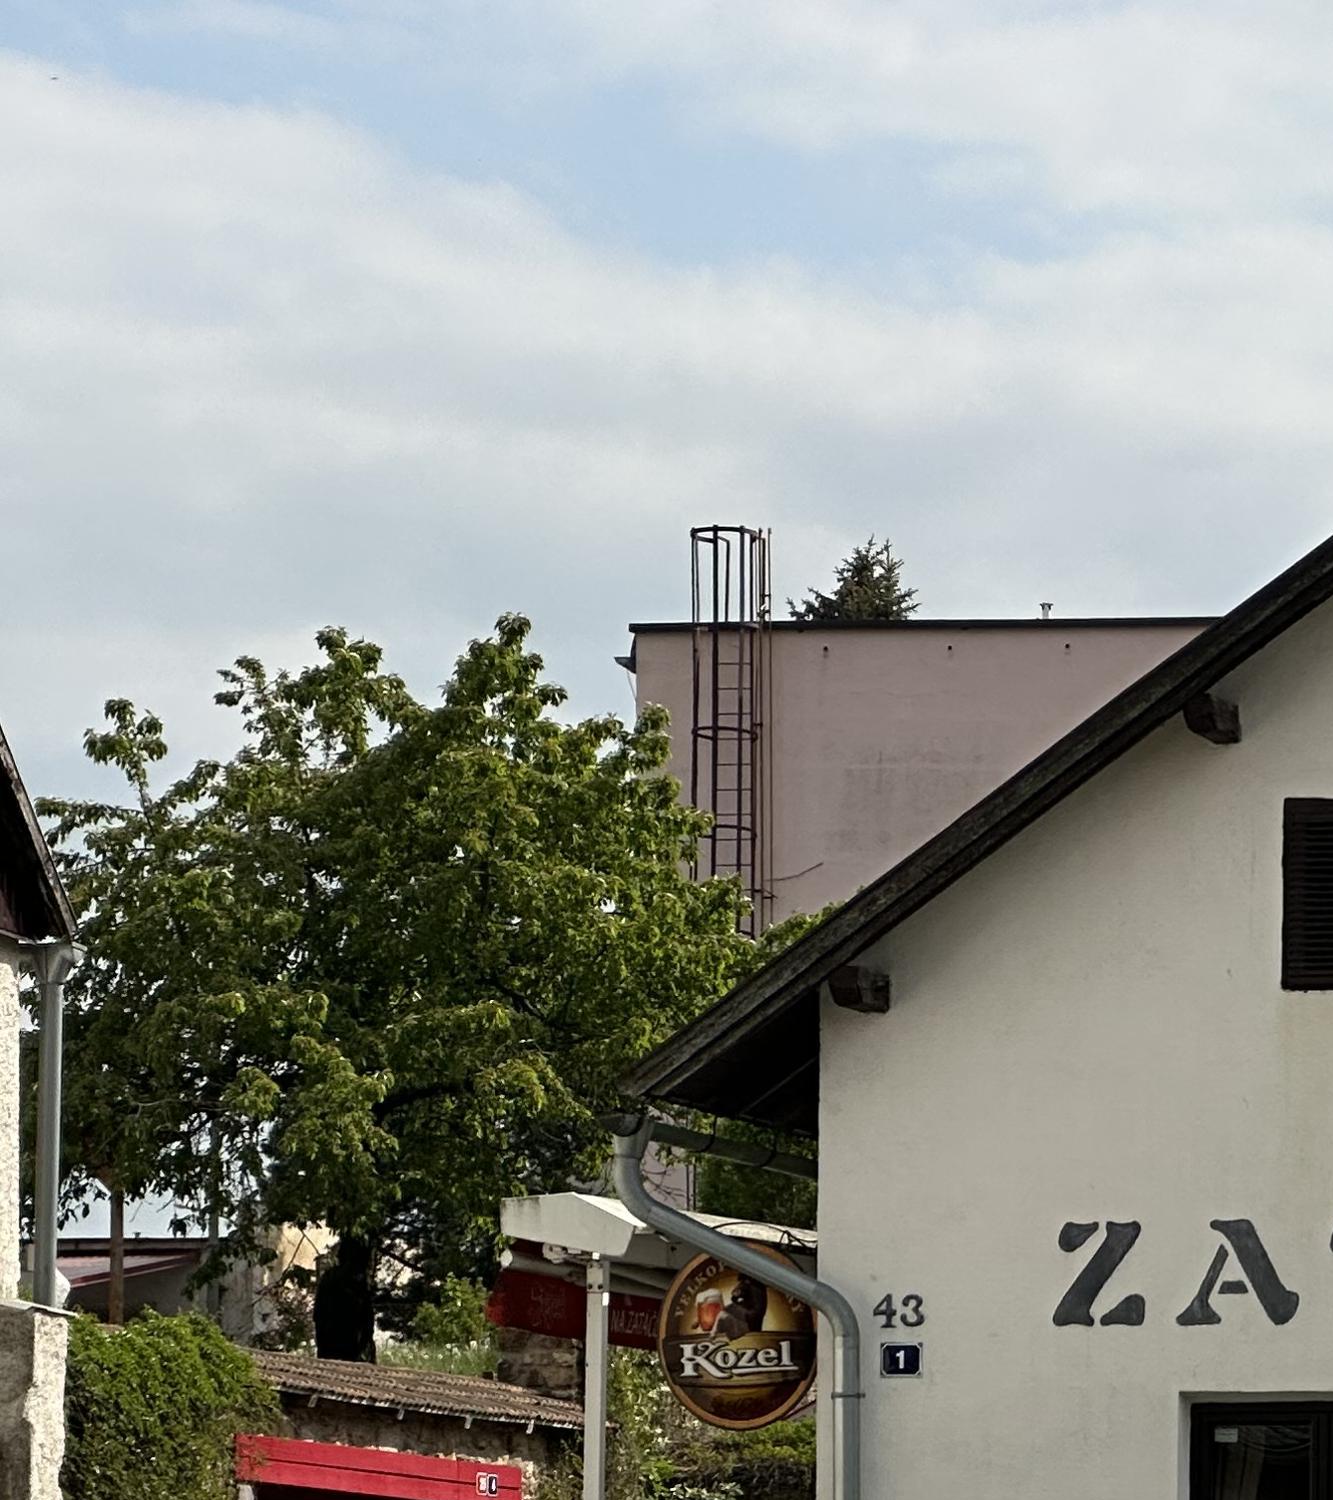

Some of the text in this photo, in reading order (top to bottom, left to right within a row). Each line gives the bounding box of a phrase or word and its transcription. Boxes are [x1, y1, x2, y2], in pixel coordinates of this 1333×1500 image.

[873, 1293, 925, 1329] 43
[680, 1340, 799, 1379] Kozel
[896, 1349, 905, 1370] 1
